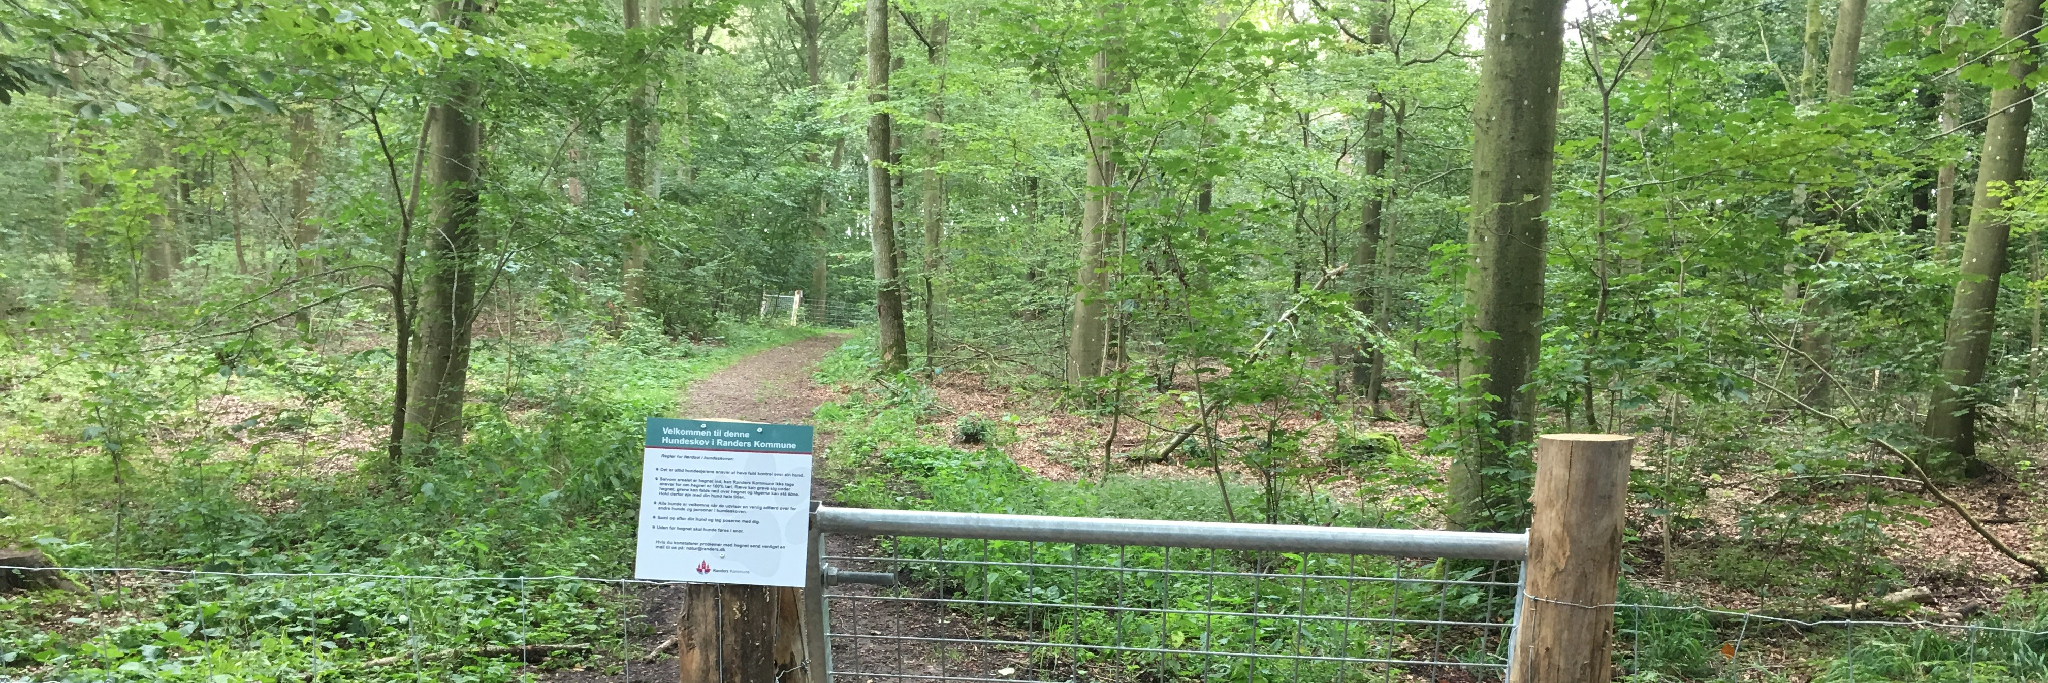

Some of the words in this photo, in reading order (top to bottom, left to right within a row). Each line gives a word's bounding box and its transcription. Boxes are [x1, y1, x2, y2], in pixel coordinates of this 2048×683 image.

[662, 426, 712, 437] Velkommen
[713, 428, 722, 437] til
[662, 436, 710, 446] Hundeskov
[716, 439, 751, 448] Randers
[753, 440, 796, 449] Kommune
